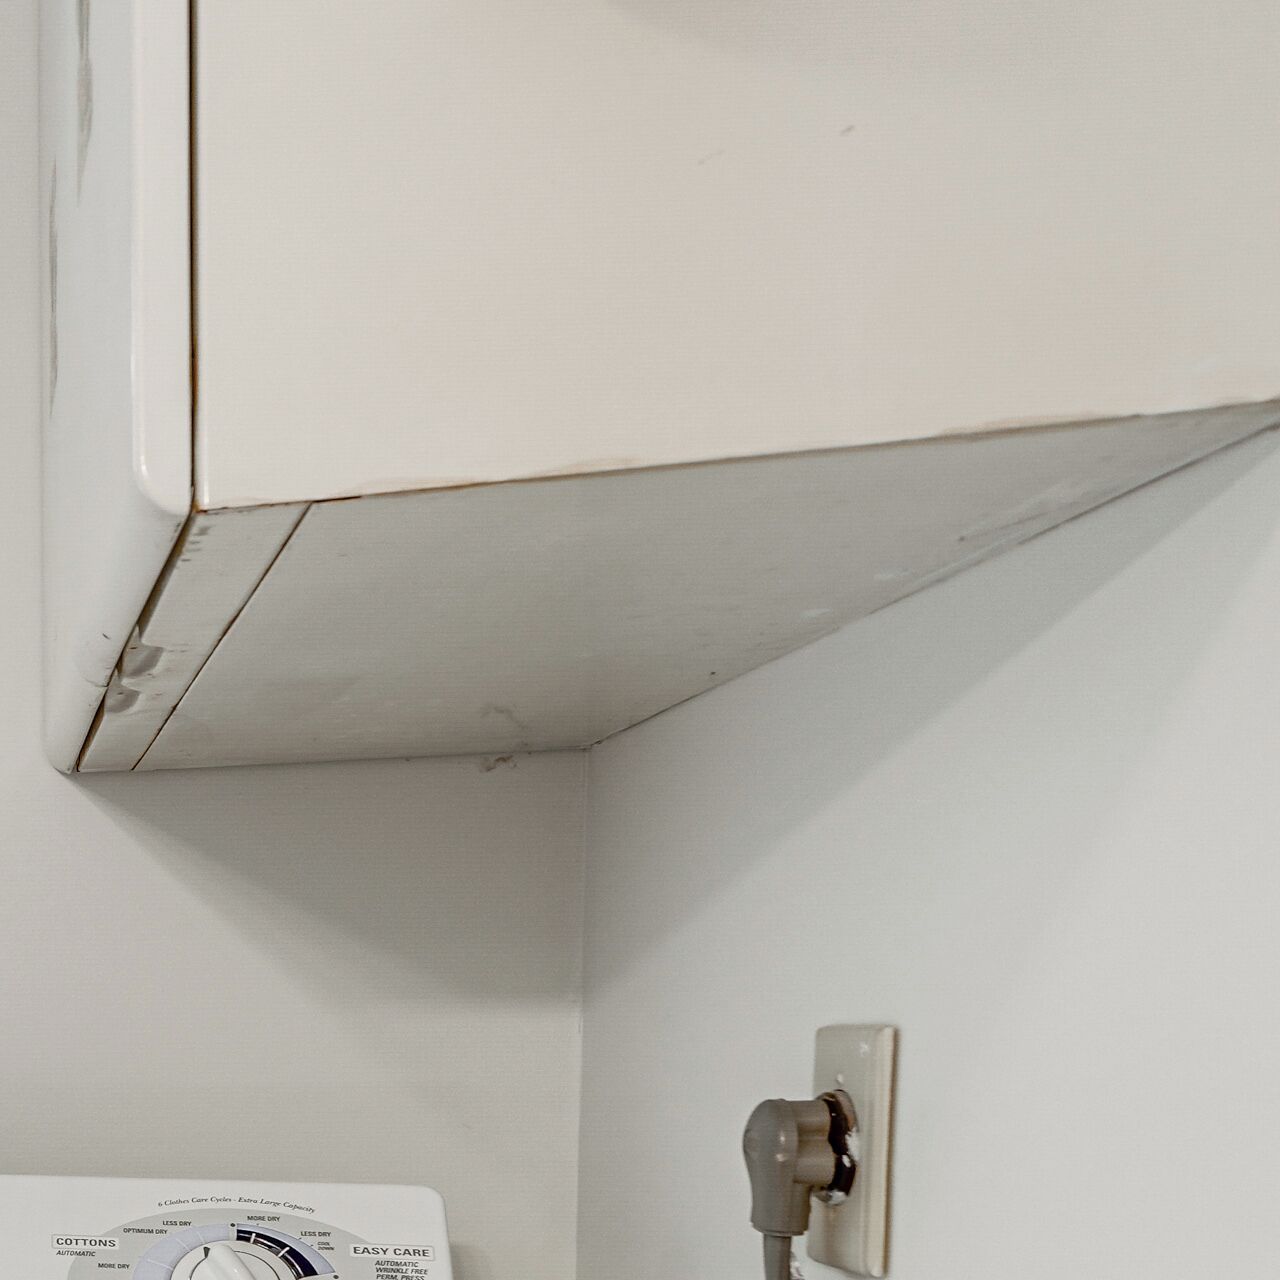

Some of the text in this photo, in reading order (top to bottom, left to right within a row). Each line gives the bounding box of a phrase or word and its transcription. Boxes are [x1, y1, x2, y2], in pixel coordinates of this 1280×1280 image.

[164, 1198, 190, 1206] Clothes
[238, 1196, 258, 1204] Extra
[260, 1198, 281, 1207] Large
[283, 1200, 316, 1214] Capacity
[56, 1237, 116, 1248] COTTONS
[353, 1246, 430, 1257] EASY CARE
